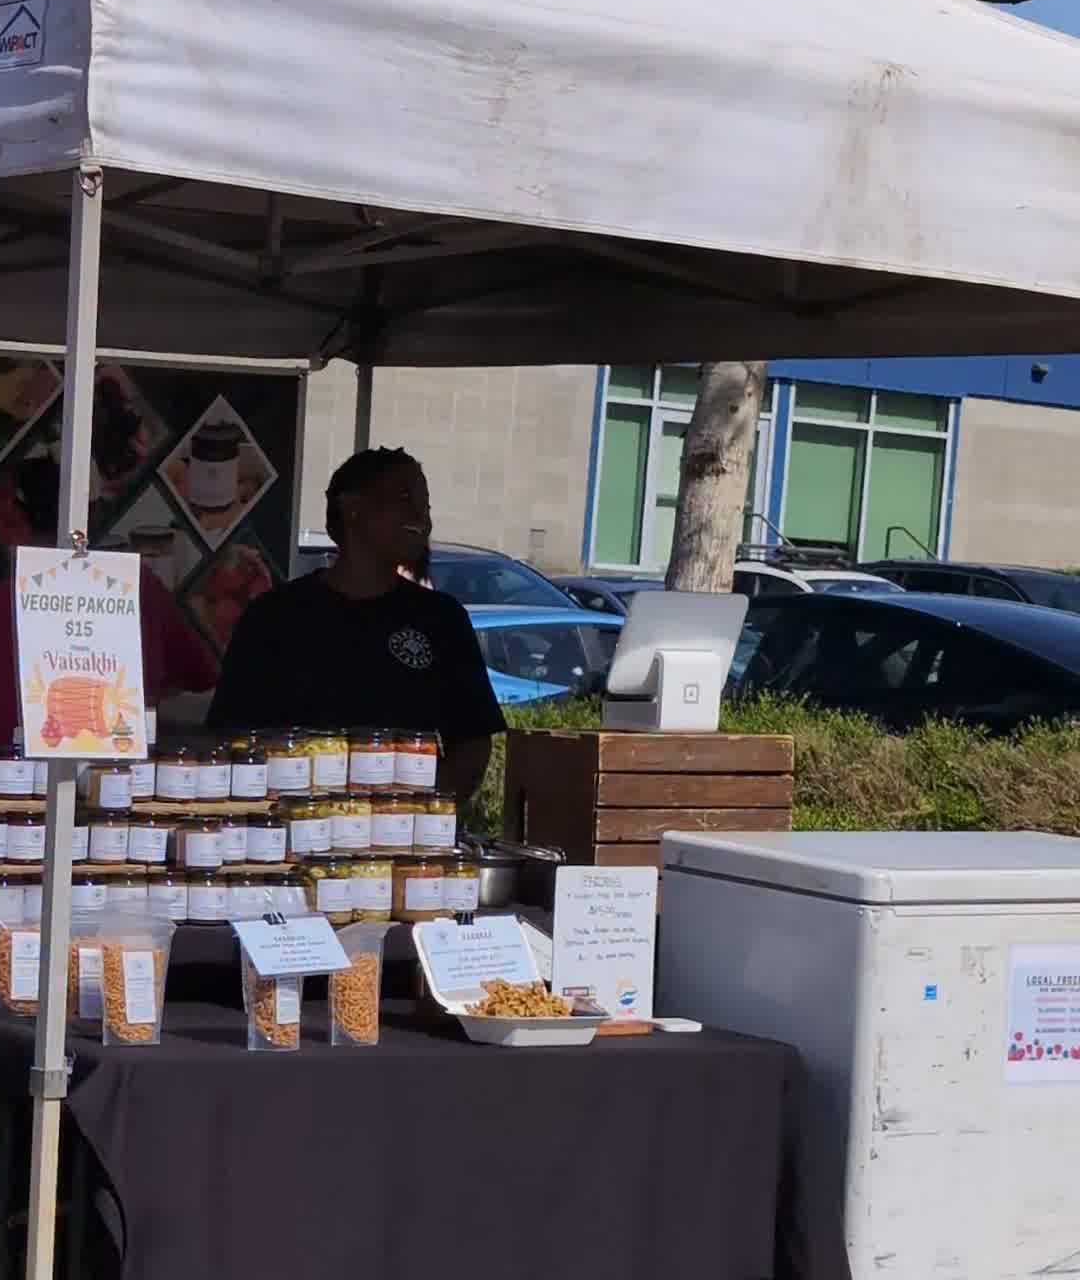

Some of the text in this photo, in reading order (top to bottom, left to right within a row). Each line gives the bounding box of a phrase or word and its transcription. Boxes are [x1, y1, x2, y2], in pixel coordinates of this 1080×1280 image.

[21, 593, 136, 616] VEGGIE PAKORA
[65, 620, 93, 637] $15
[43, 649, 117, 676] Vaisakhi
[1026, 975, 1080, 986] LOCAL FROZ
